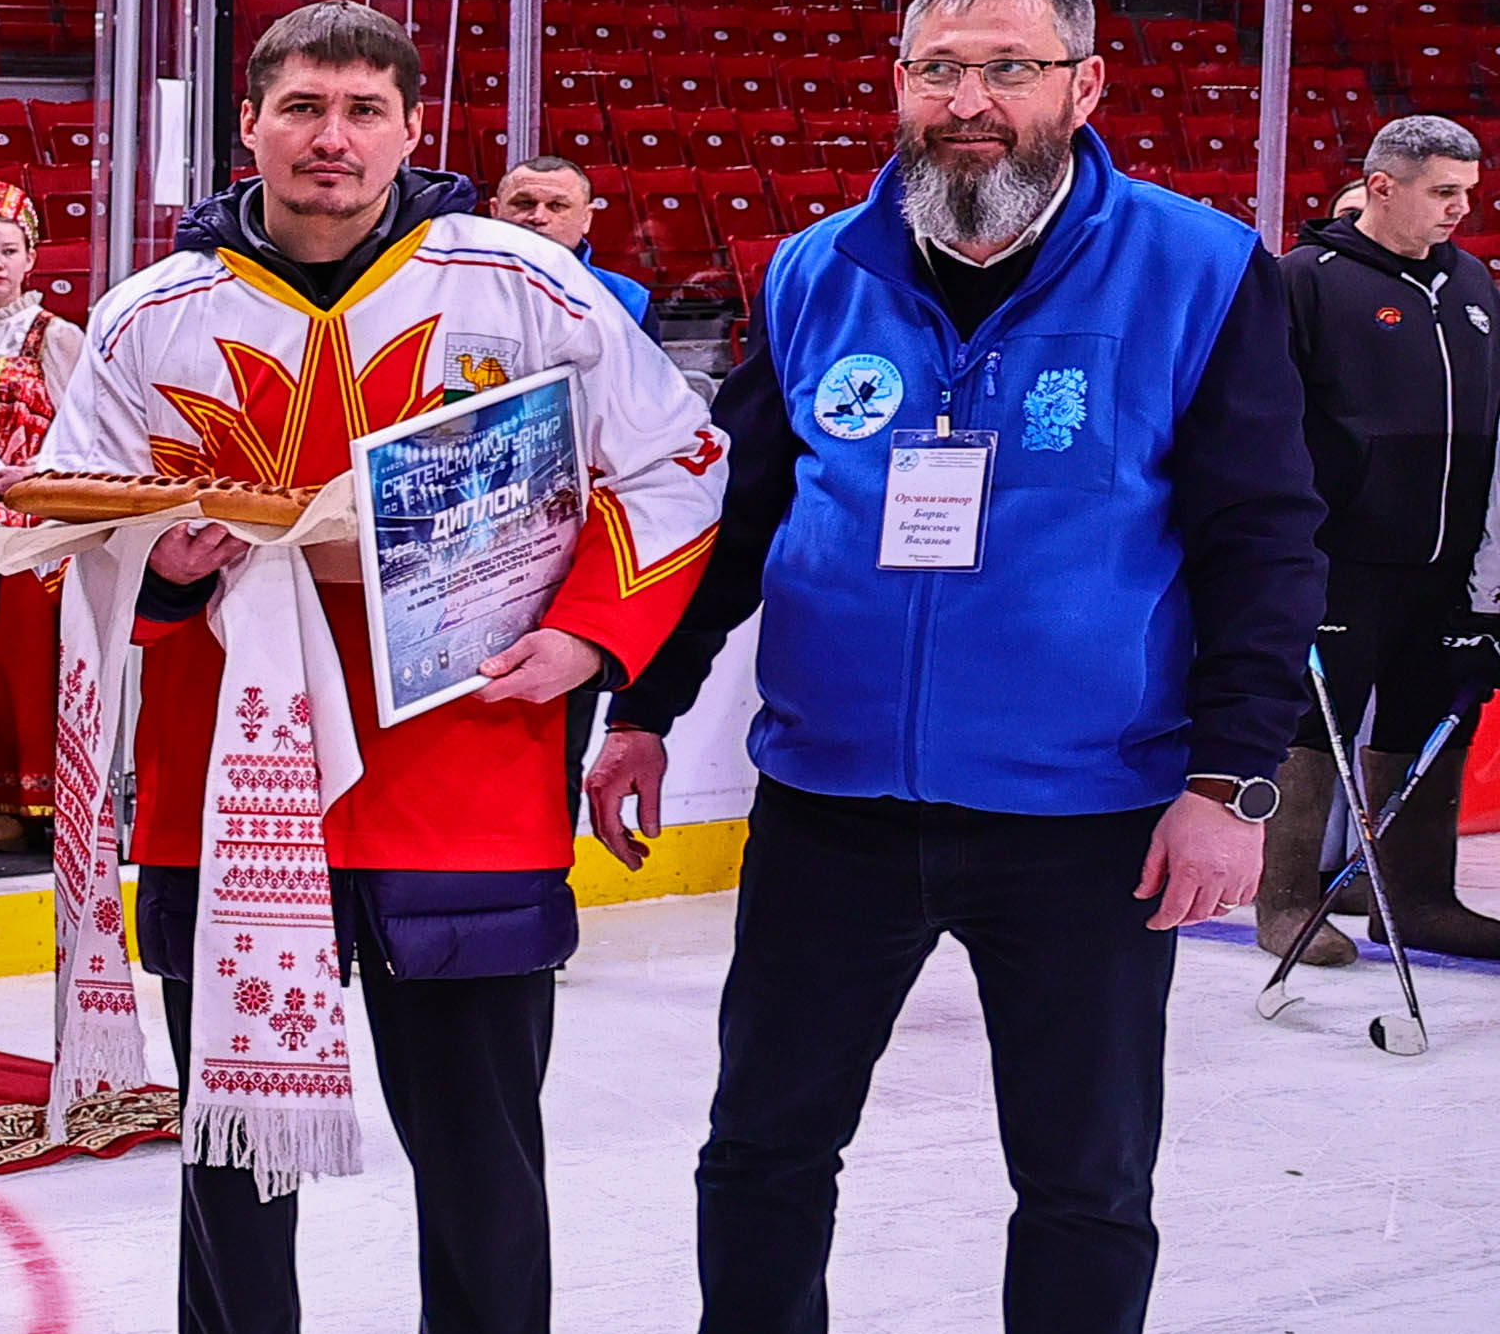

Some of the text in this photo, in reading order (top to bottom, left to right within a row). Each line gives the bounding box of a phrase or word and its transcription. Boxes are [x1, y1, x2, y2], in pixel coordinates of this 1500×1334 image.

[894, 492, 973, 505] Организатор
[431, 478, 530, 540] ДИПЛОМ
[913, 507, 950, 519] Борис
[898, 521, 961, 535] Борисович
